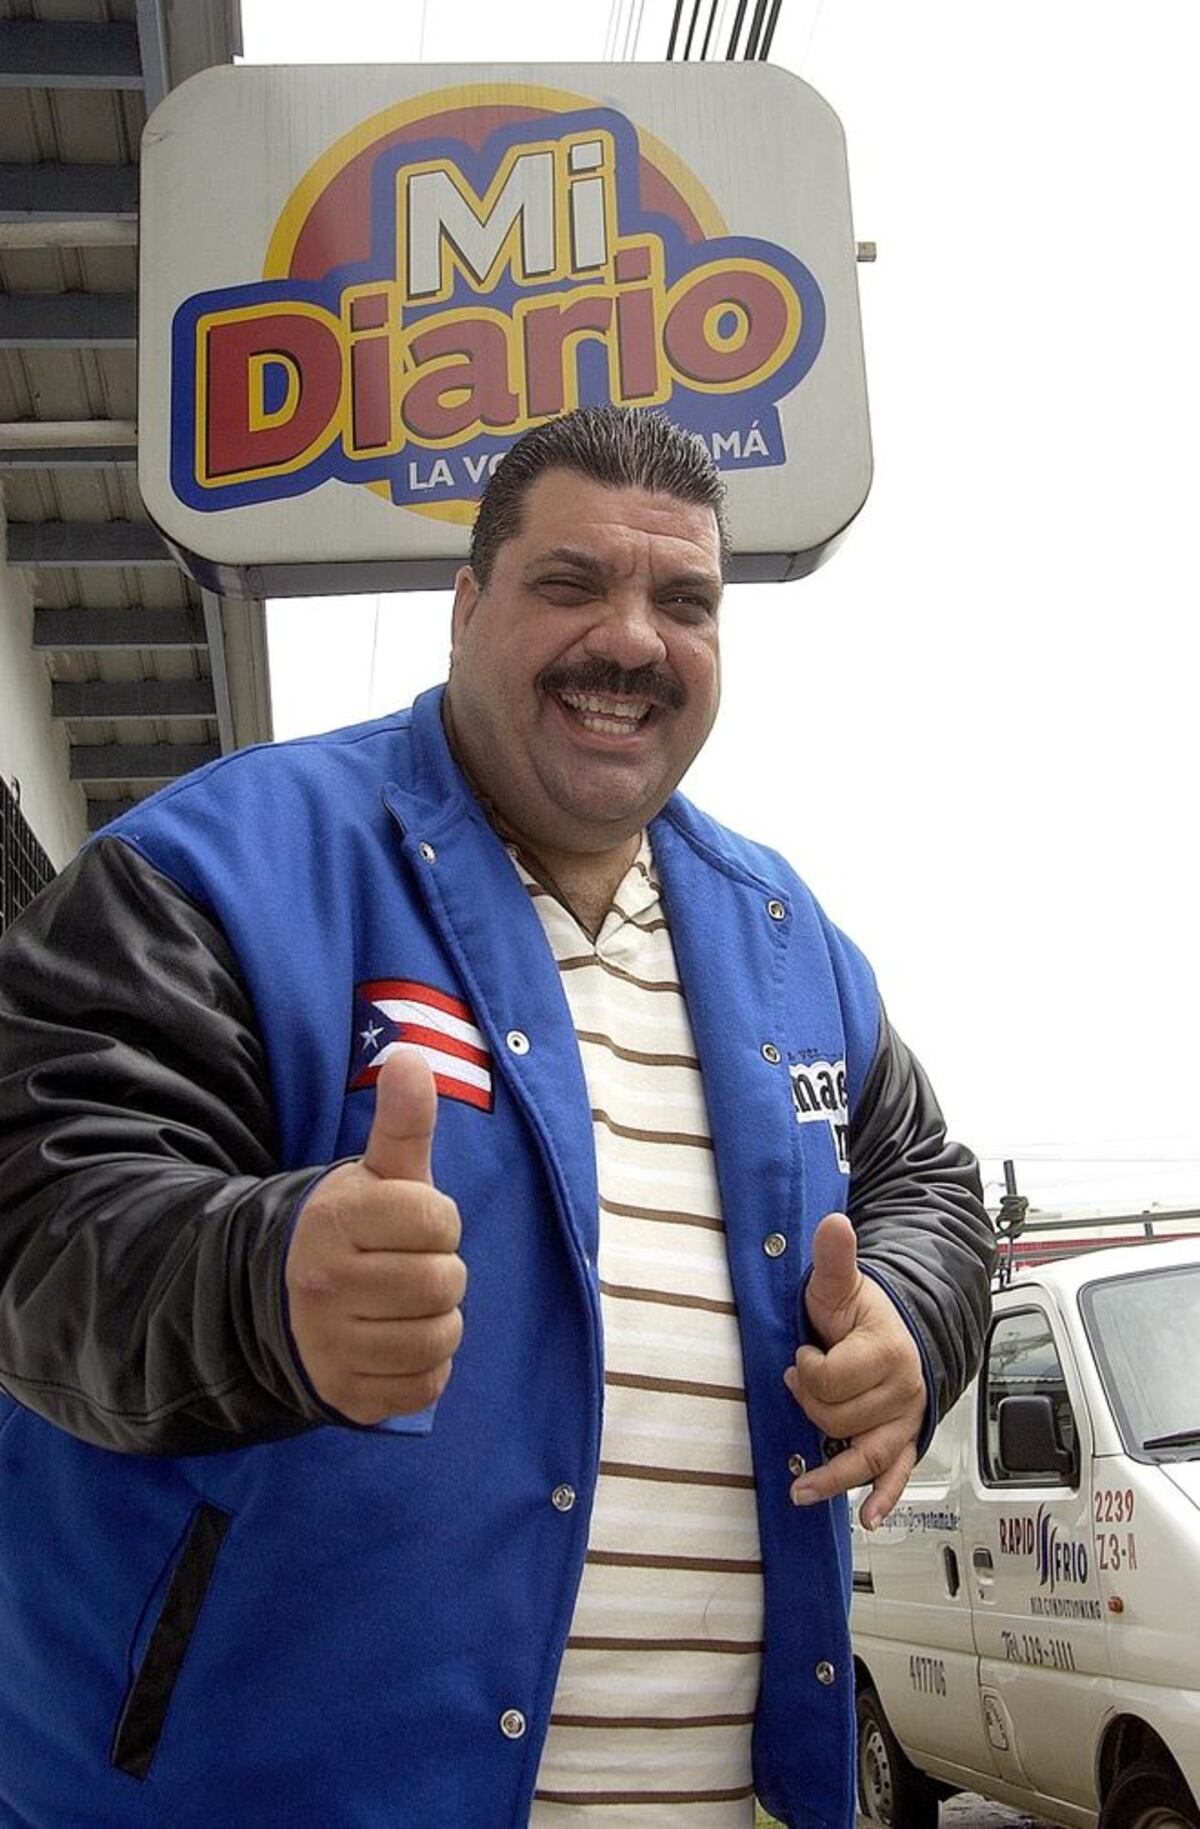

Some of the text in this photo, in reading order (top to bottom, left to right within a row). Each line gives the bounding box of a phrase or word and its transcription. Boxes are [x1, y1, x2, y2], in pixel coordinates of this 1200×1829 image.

[406, 139, 606, 299] Mi
[205, 246, 788, 478] Diario
[409, 459, 455, 490] LA
[1095, 1489, 1134, 1522] 2239
[1000, 1517, 1035, 1555] RAPID
[1055, 1542, 1088, 1584] FRIO
